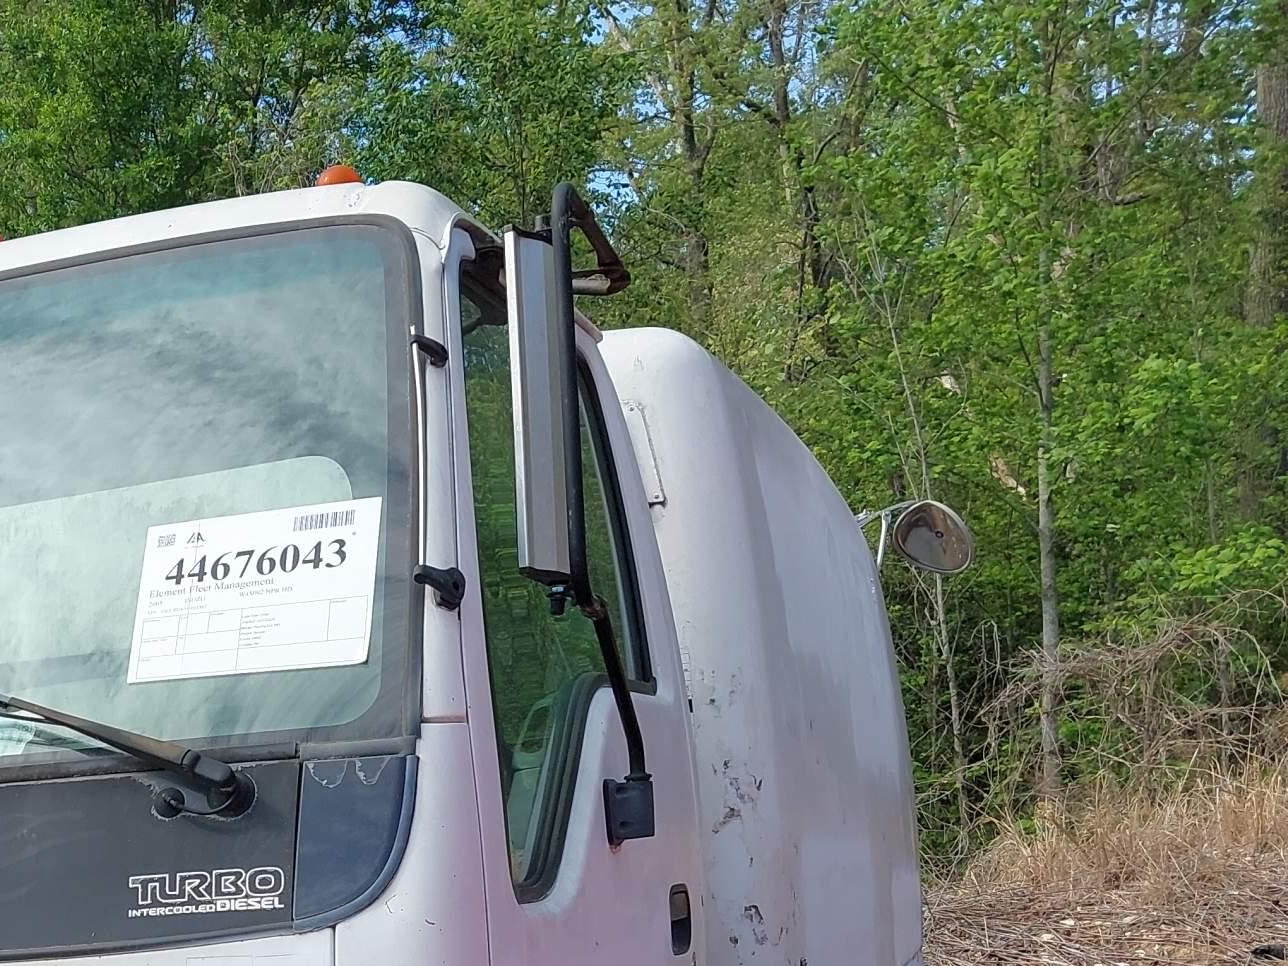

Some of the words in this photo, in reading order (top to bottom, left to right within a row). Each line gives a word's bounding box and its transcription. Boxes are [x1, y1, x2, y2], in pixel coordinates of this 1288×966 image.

[165, 538, 347, 585] 44676043
[149, 587, 186, 598] Element
[189, 584, 212, 594] Fleet
[214, 577, 274, 592] Management
[129, 866, 284, 905] TURBO
[128, 904, 215, 917] INTERCOOLED
[216, 897, 285, 911] DIESEL
